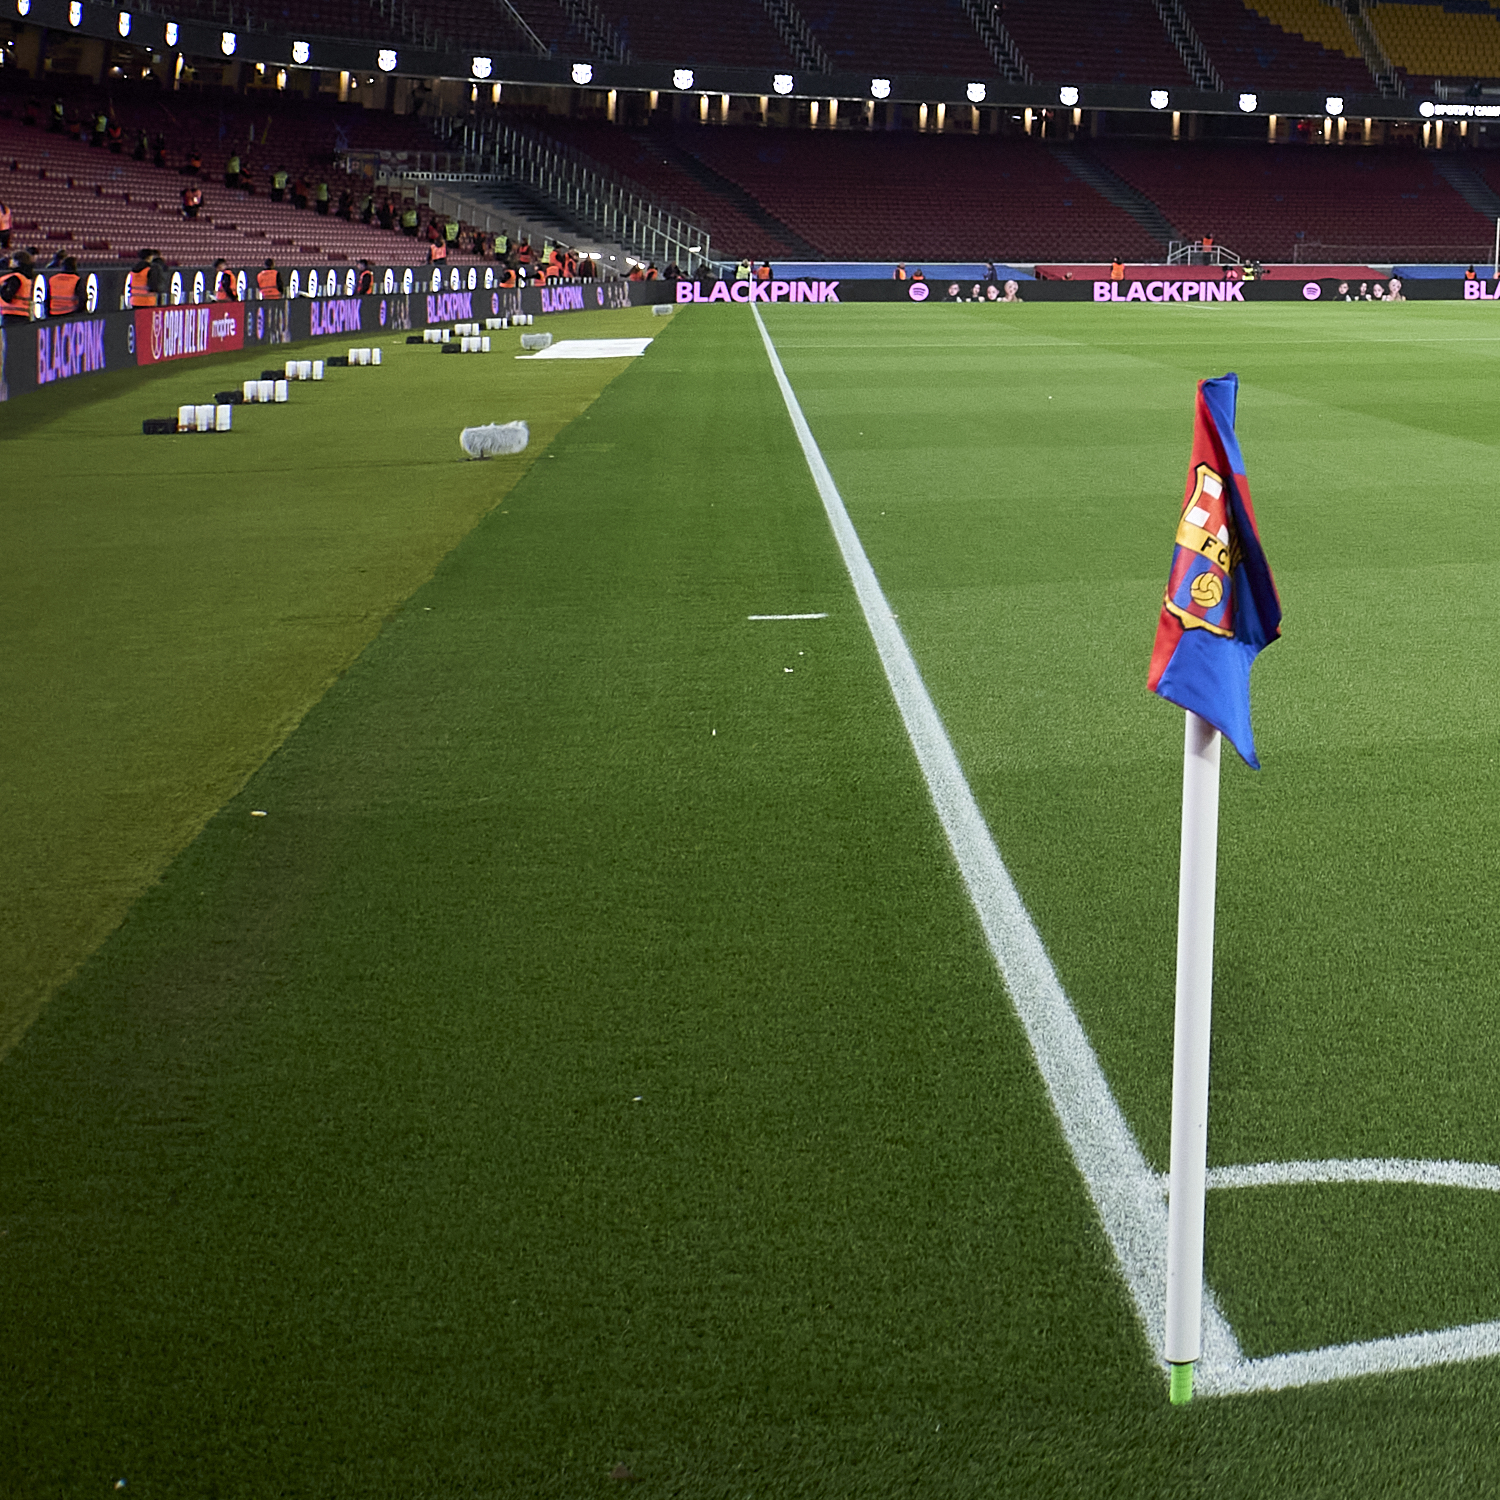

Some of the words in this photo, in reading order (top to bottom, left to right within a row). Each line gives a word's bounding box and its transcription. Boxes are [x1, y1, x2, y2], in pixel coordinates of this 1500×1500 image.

[541, 286, 585, 313] BLACKPINK
[676, 281, 840, 303] BLACKPINK
[1093, 281, 1246, 302] BLACKPINK
[310, 298, 362, 336] BLACKPINK
[427, 292, 473, 324] BLACKPINK
[164, 309, 183, 357] COPA
[37, 319, 105, 384] BLACKPINK
